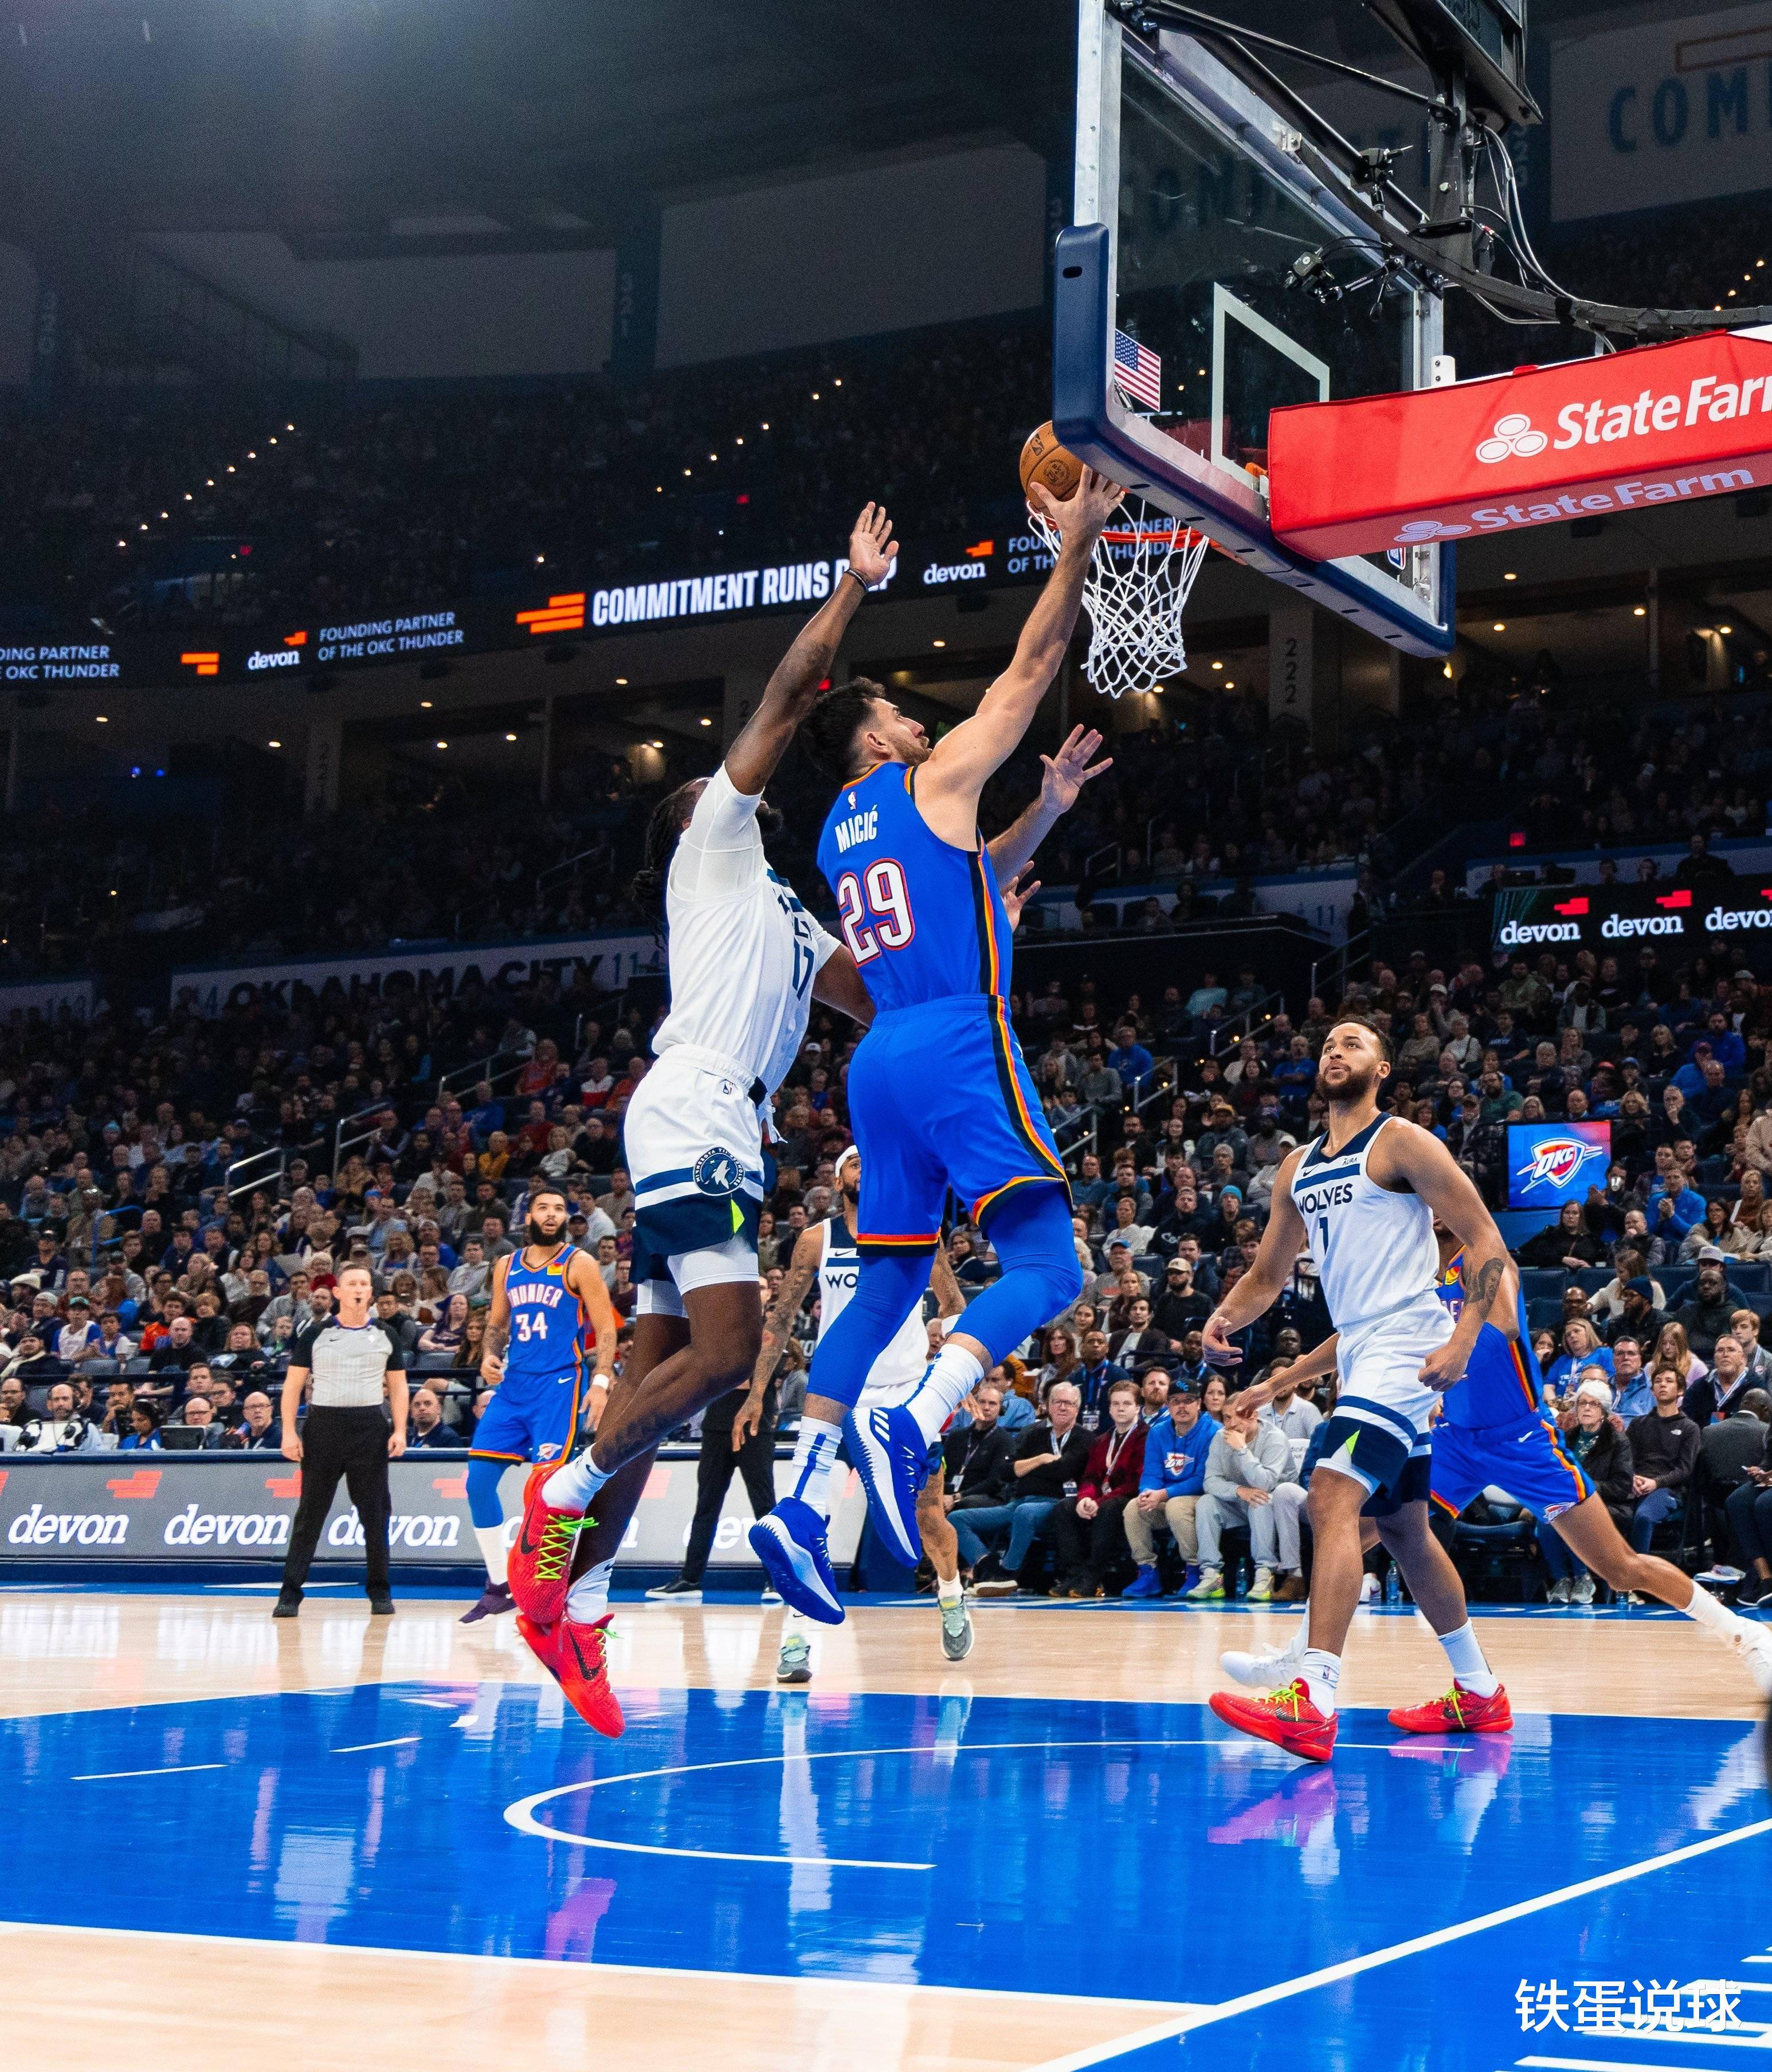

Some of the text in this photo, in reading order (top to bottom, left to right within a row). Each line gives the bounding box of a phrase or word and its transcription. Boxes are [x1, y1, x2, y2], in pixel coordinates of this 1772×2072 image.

[1609, 68, 1772, 153] COM
[1553, 389, 1680, 450] State
[1470, 468, 1754, 529] State Farm
[923, 561, 986, 585] devon
[1007, 555, 1029, 574] OF
[593, 570, 758, 626] COMMITMENT
[762, 561, 829, 603] RUNS
[319, 611, 455, 642] FOUNDING PARTNER
[40, 645, 111, 660] PARTNER
[248, 650, 300, 670] devon
[317, 629, 464, 661] OF THE OKC THUNDER
[6, 665, 39, 680] OKC
[42, 663, 120, 679] THUNDER
[1285, 638, 1297, 704] 222
[834, 803, 878, 853] MICIĆ
[837, 858, 916, 968] 29
[1601, 913, 1684, 939] devon
[1500, 920, 1581, 944] devon
[1319, 1216, 1329, 1256] 1
[515, 1310, 548, 1342] 34
[8, 1504, 130, 1545] devon
[163, 1504, 291, 1545] devon
